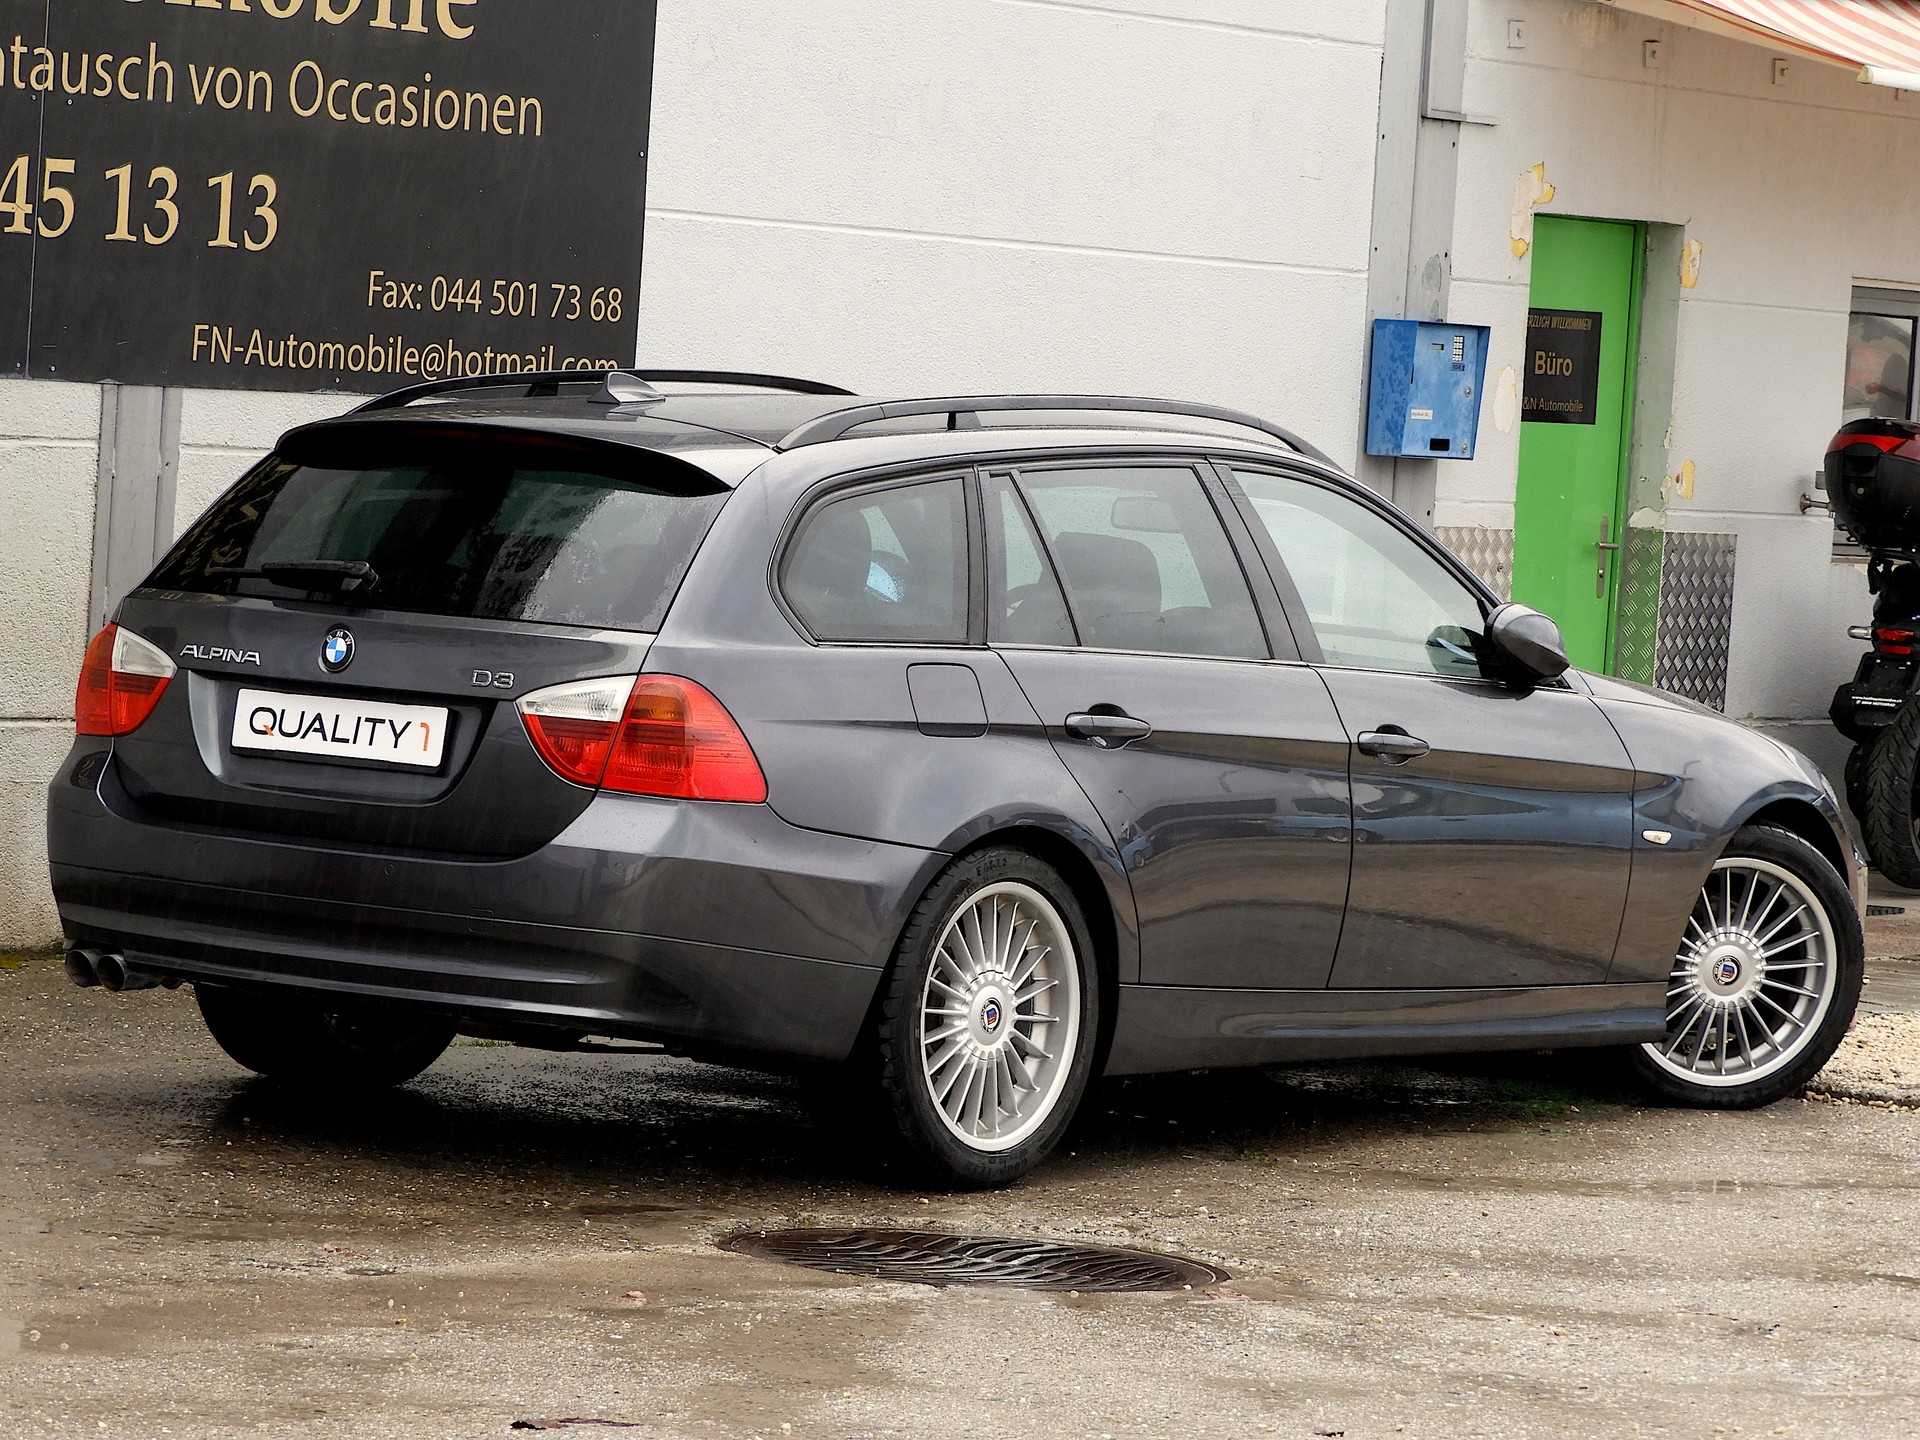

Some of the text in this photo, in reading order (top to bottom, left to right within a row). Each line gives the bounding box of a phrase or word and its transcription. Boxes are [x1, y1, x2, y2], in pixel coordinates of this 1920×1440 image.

[0, 35, 543, 137] tausch von Occasionen
[104, 162, 180, 246] 13
[207, 171, 279, 252] 13
[368, 269, 623, 323] Fax: 044 501 73 68
[1534, 350, 1573, 377] Büro
[1539, 397, 1584, 412] Automobile
[179, 643, 261, 666] ALPINA
[470, 669, 515, 689] D3
[249, 706, 412, 749] QUALITY
